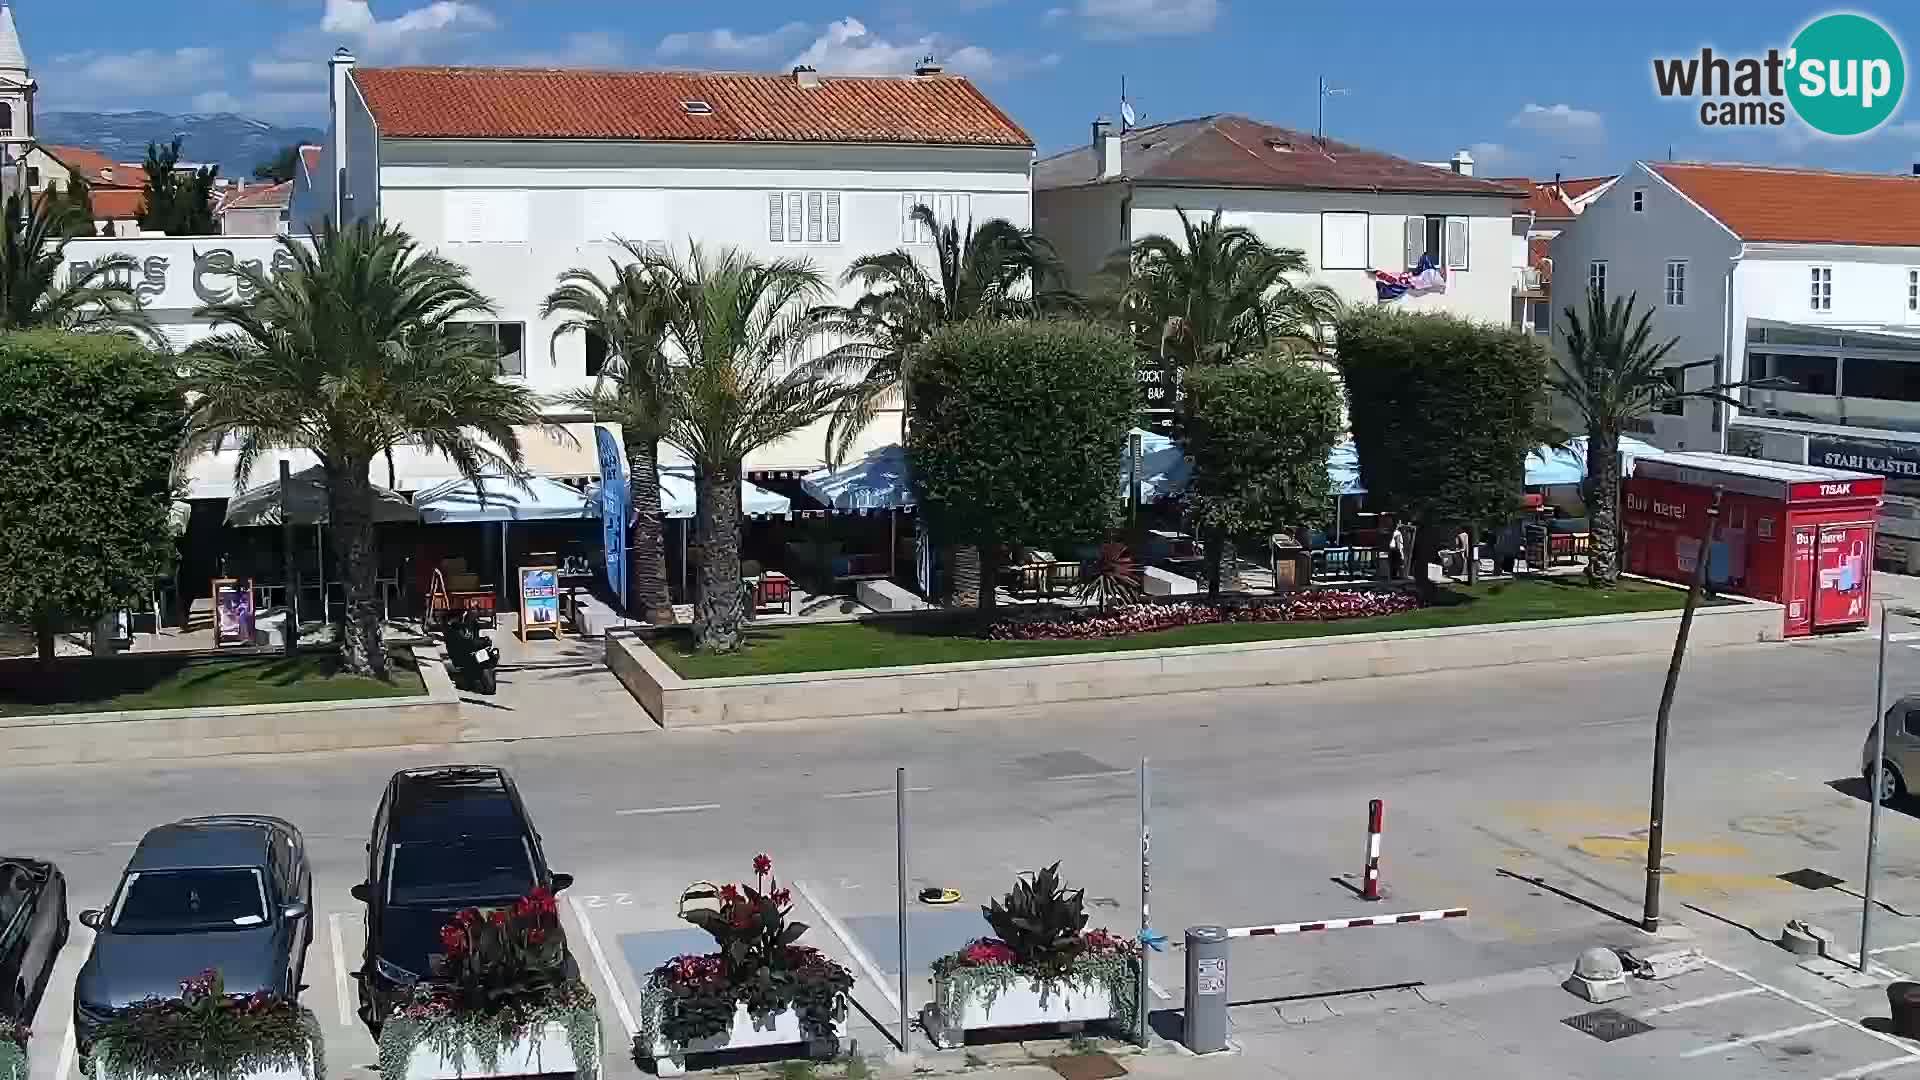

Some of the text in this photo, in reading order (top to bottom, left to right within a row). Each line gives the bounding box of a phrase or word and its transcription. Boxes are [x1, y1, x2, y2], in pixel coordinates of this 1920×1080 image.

[1823, 452, 1863, 469] STARI
[1819, 483, 1852, 496] TISAK
[1626, 493, 1687, 519] Buy here!
[1796, 530, 1847, 546] Buy here!
